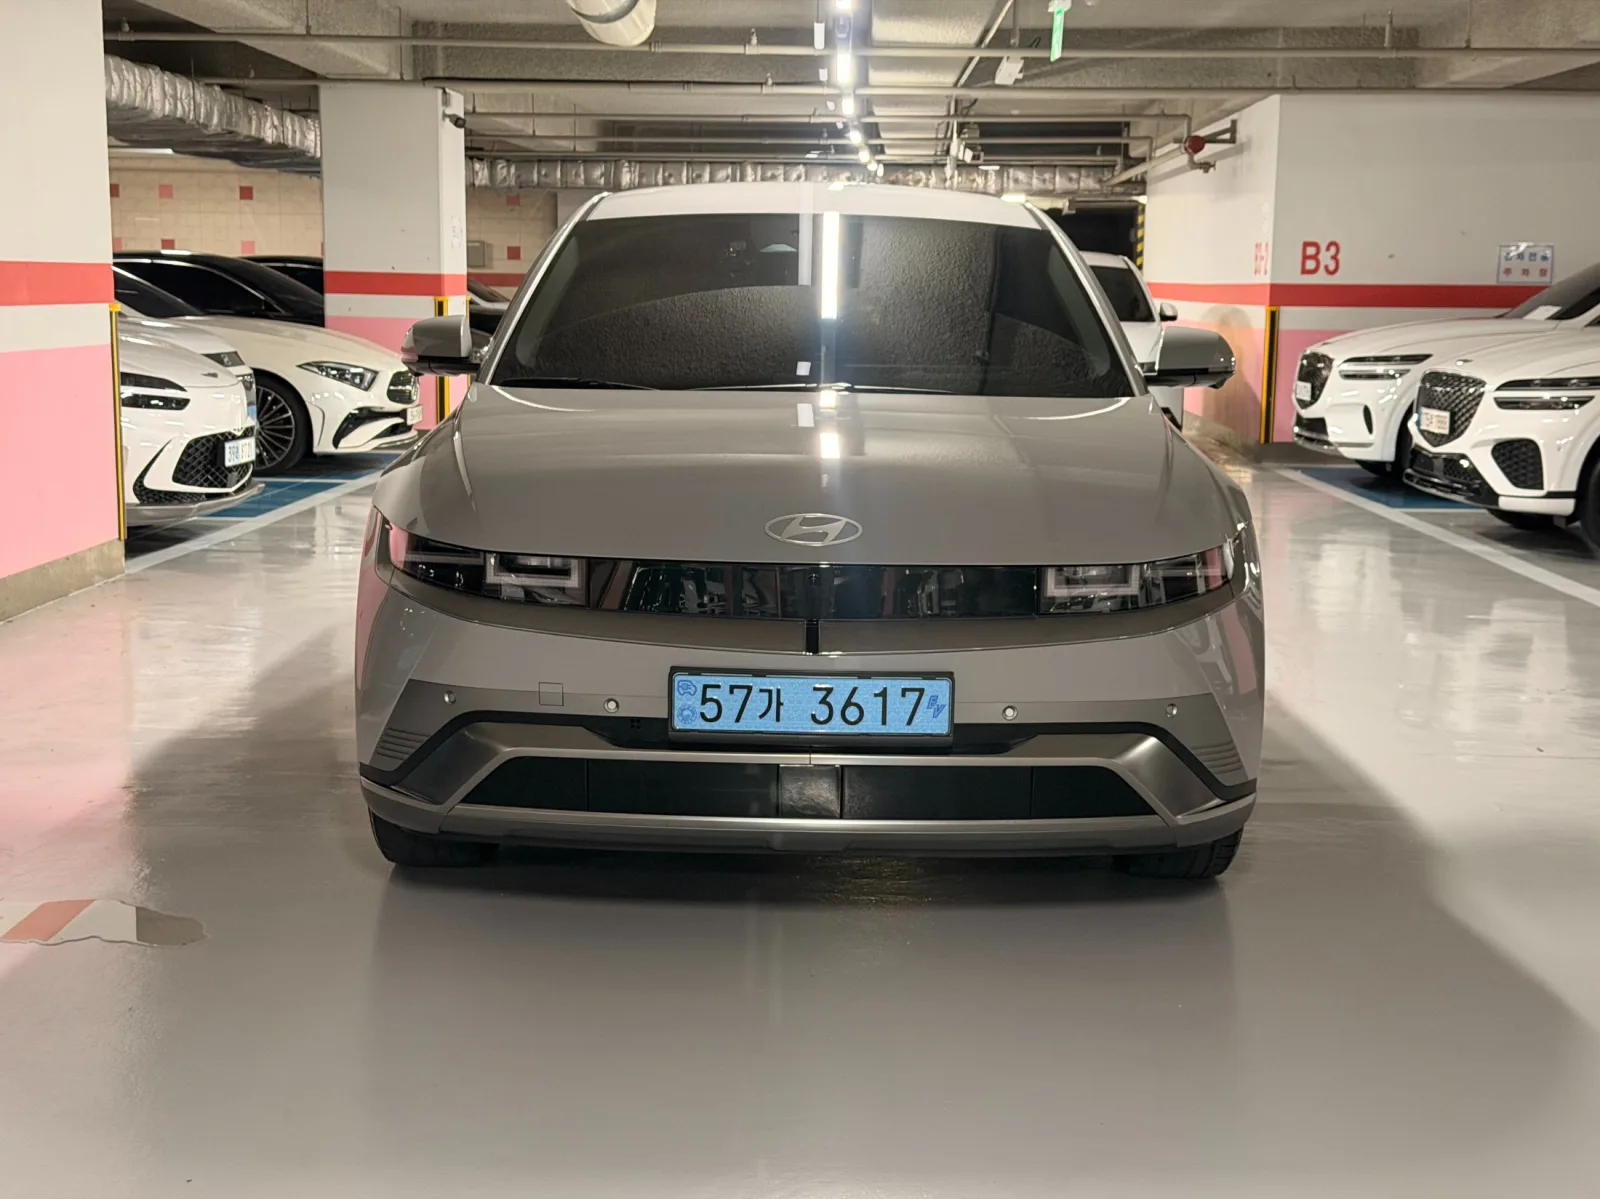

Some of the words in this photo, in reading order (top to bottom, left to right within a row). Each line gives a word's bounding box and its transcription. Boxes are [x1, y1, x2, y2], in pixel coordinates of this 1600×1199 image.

[1300, 240, 1340, 276] B3
[699, 683, 784, 724] 57가
[810, 685, 926, 726] 3617
[927, 695, 946, 718] EV
